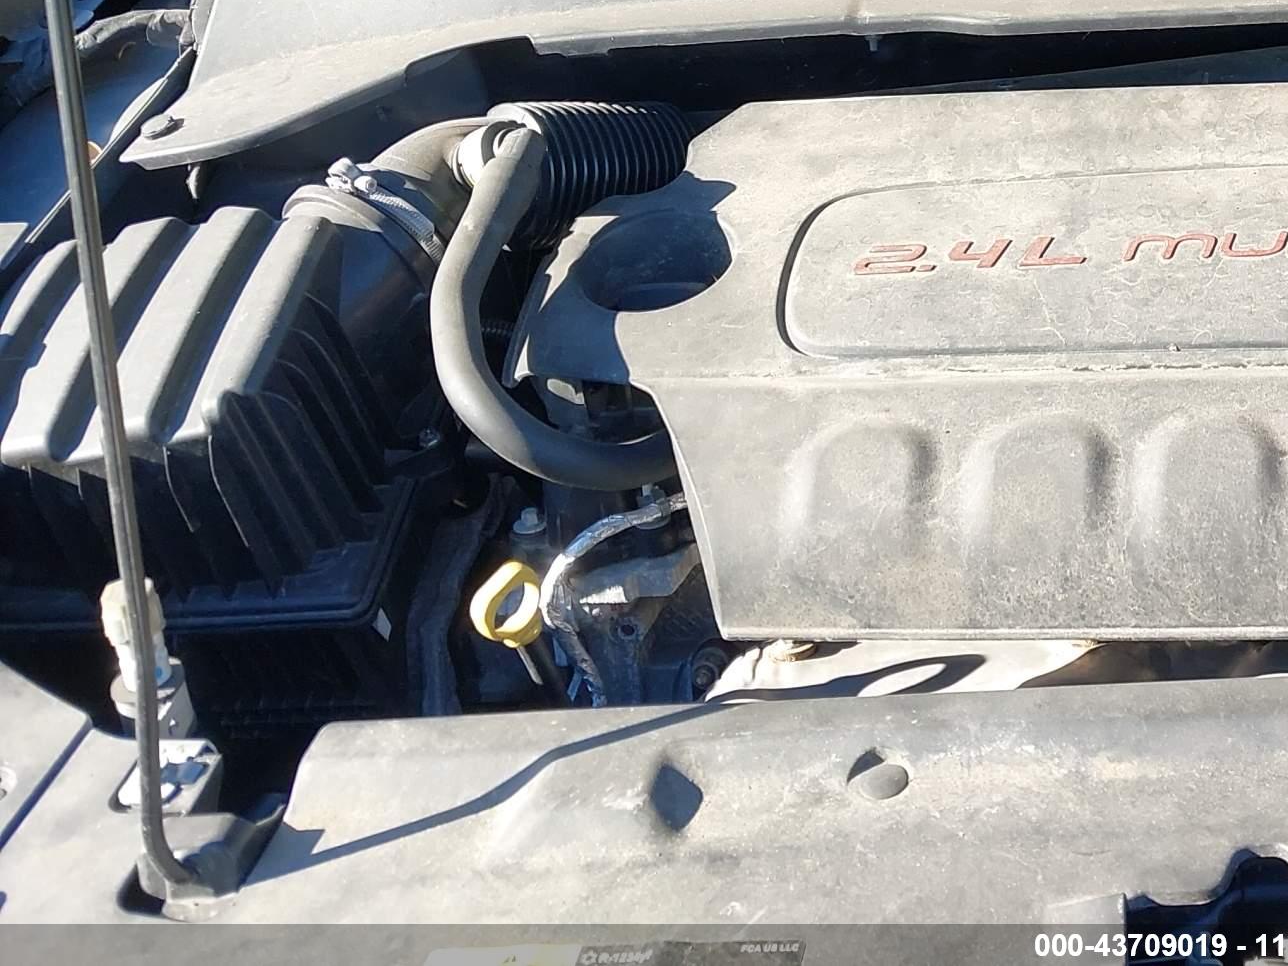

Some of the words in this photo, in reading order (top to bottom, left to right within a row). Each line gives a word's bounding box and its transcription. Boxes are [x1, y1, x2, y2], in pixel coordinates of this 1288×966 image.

[740, 943, 762, 953] FCA
[762, 943, 778, 953] US
[779, 943, 800, 952] LLC
